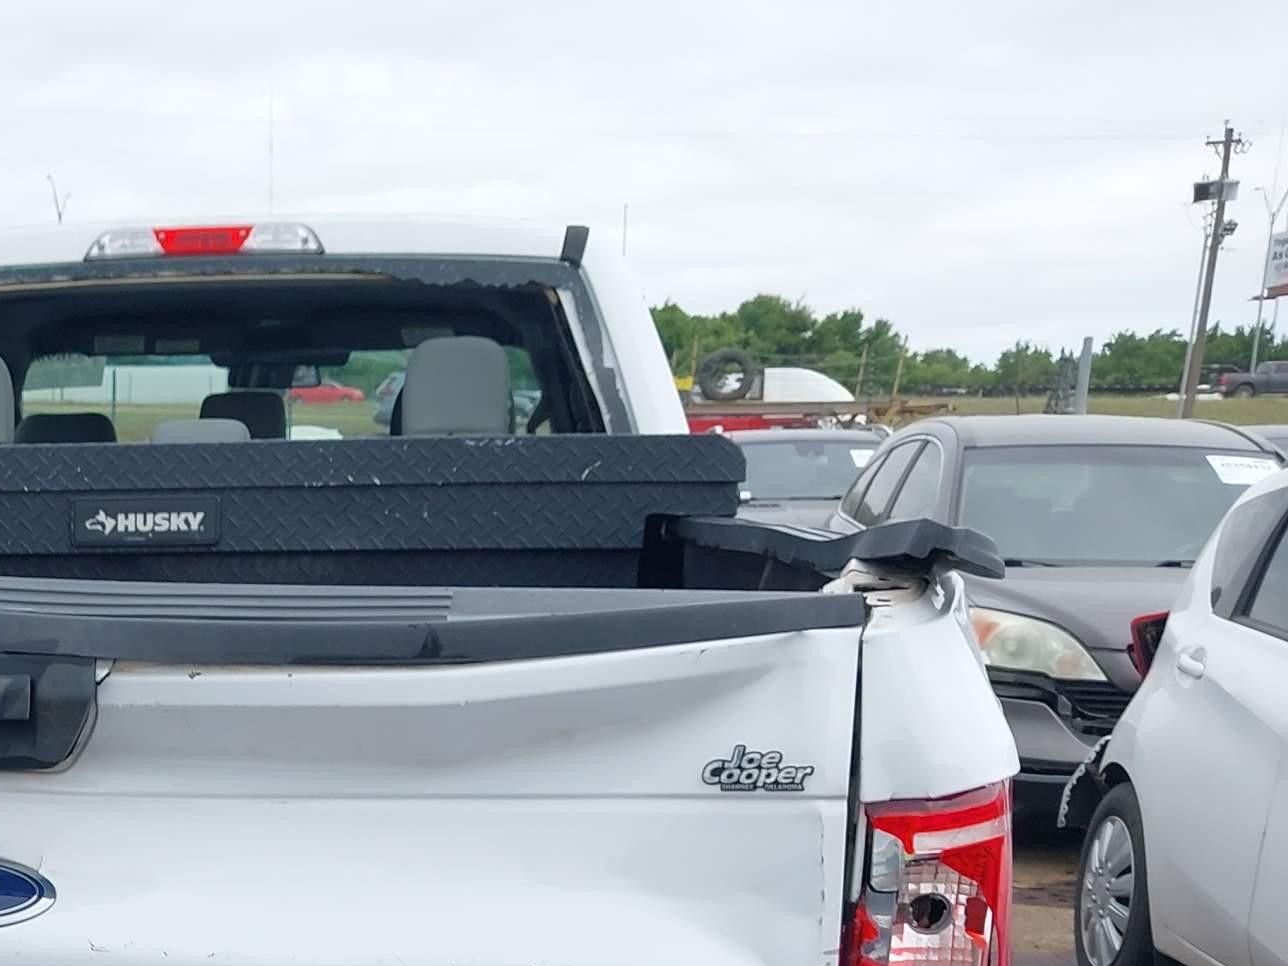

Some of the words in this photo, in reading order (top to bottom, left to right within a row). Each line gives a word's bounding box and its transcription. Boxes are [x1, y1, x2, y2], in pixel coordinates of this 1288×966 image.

[116, 511, 205, 532] HUSKY
[724, 744, 783, 768] Joe
[702, 759, 815, 788] Cooper
[764, 783, 803, 791] OKLAHOMA
